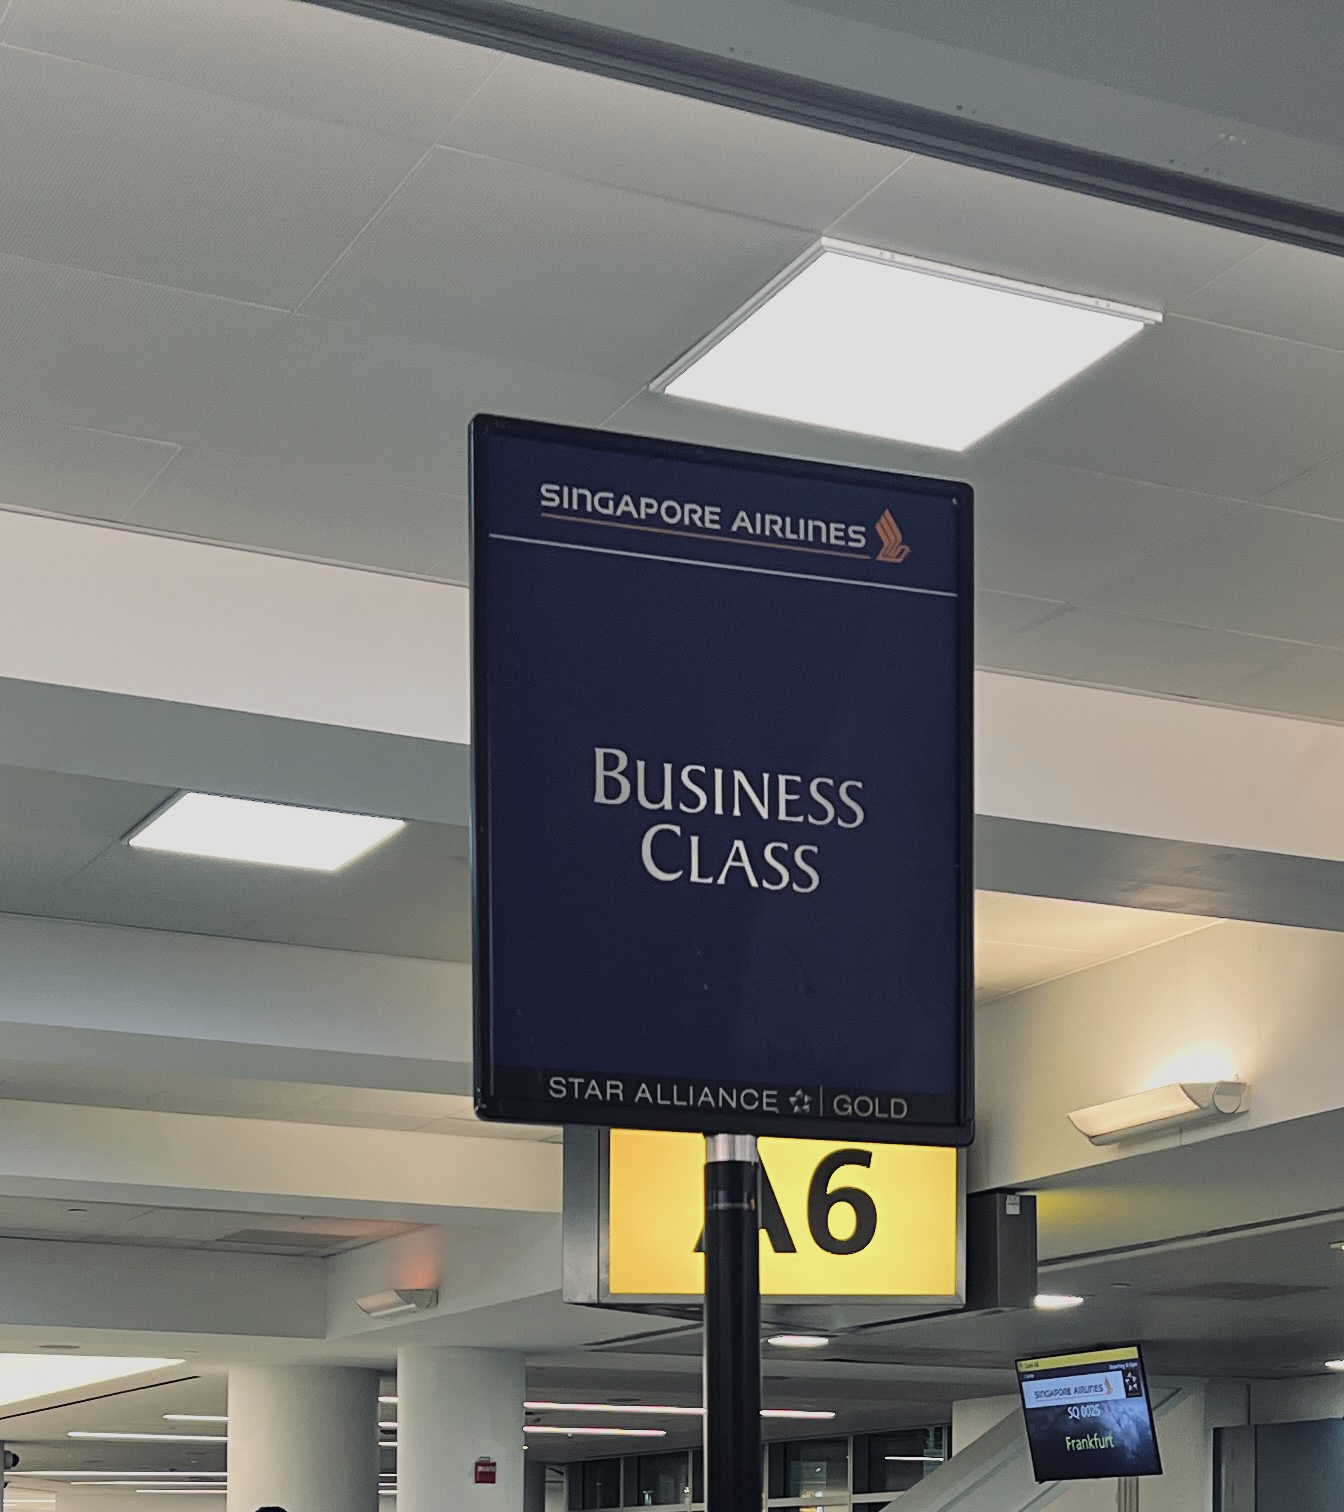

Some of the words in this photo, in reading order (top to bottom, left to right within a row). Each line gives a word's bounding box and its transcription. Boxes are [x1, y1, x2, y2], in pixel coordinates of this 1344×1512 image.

[540, 482, 722, 531] SINGAPORE
[730, 510, 867, 549] AIRLINES
[593, 747, 866, 829] BUSINESS
[641, 823, 821, 894] CLASS
[548, 1076, 624, 1102] STAR
[634, 1082, 779, 1114] ALLIANCE
[832, 1094, 908, 1120] GOLD
[1034, 1387, 1072, 1400] SINGAPORE
[1073, 1383, 1104, 1396] AIRLINES
[1067, 1406, 1080, 1420] SQ
[1065, 1432, 1115, 1452] Frankfurt
